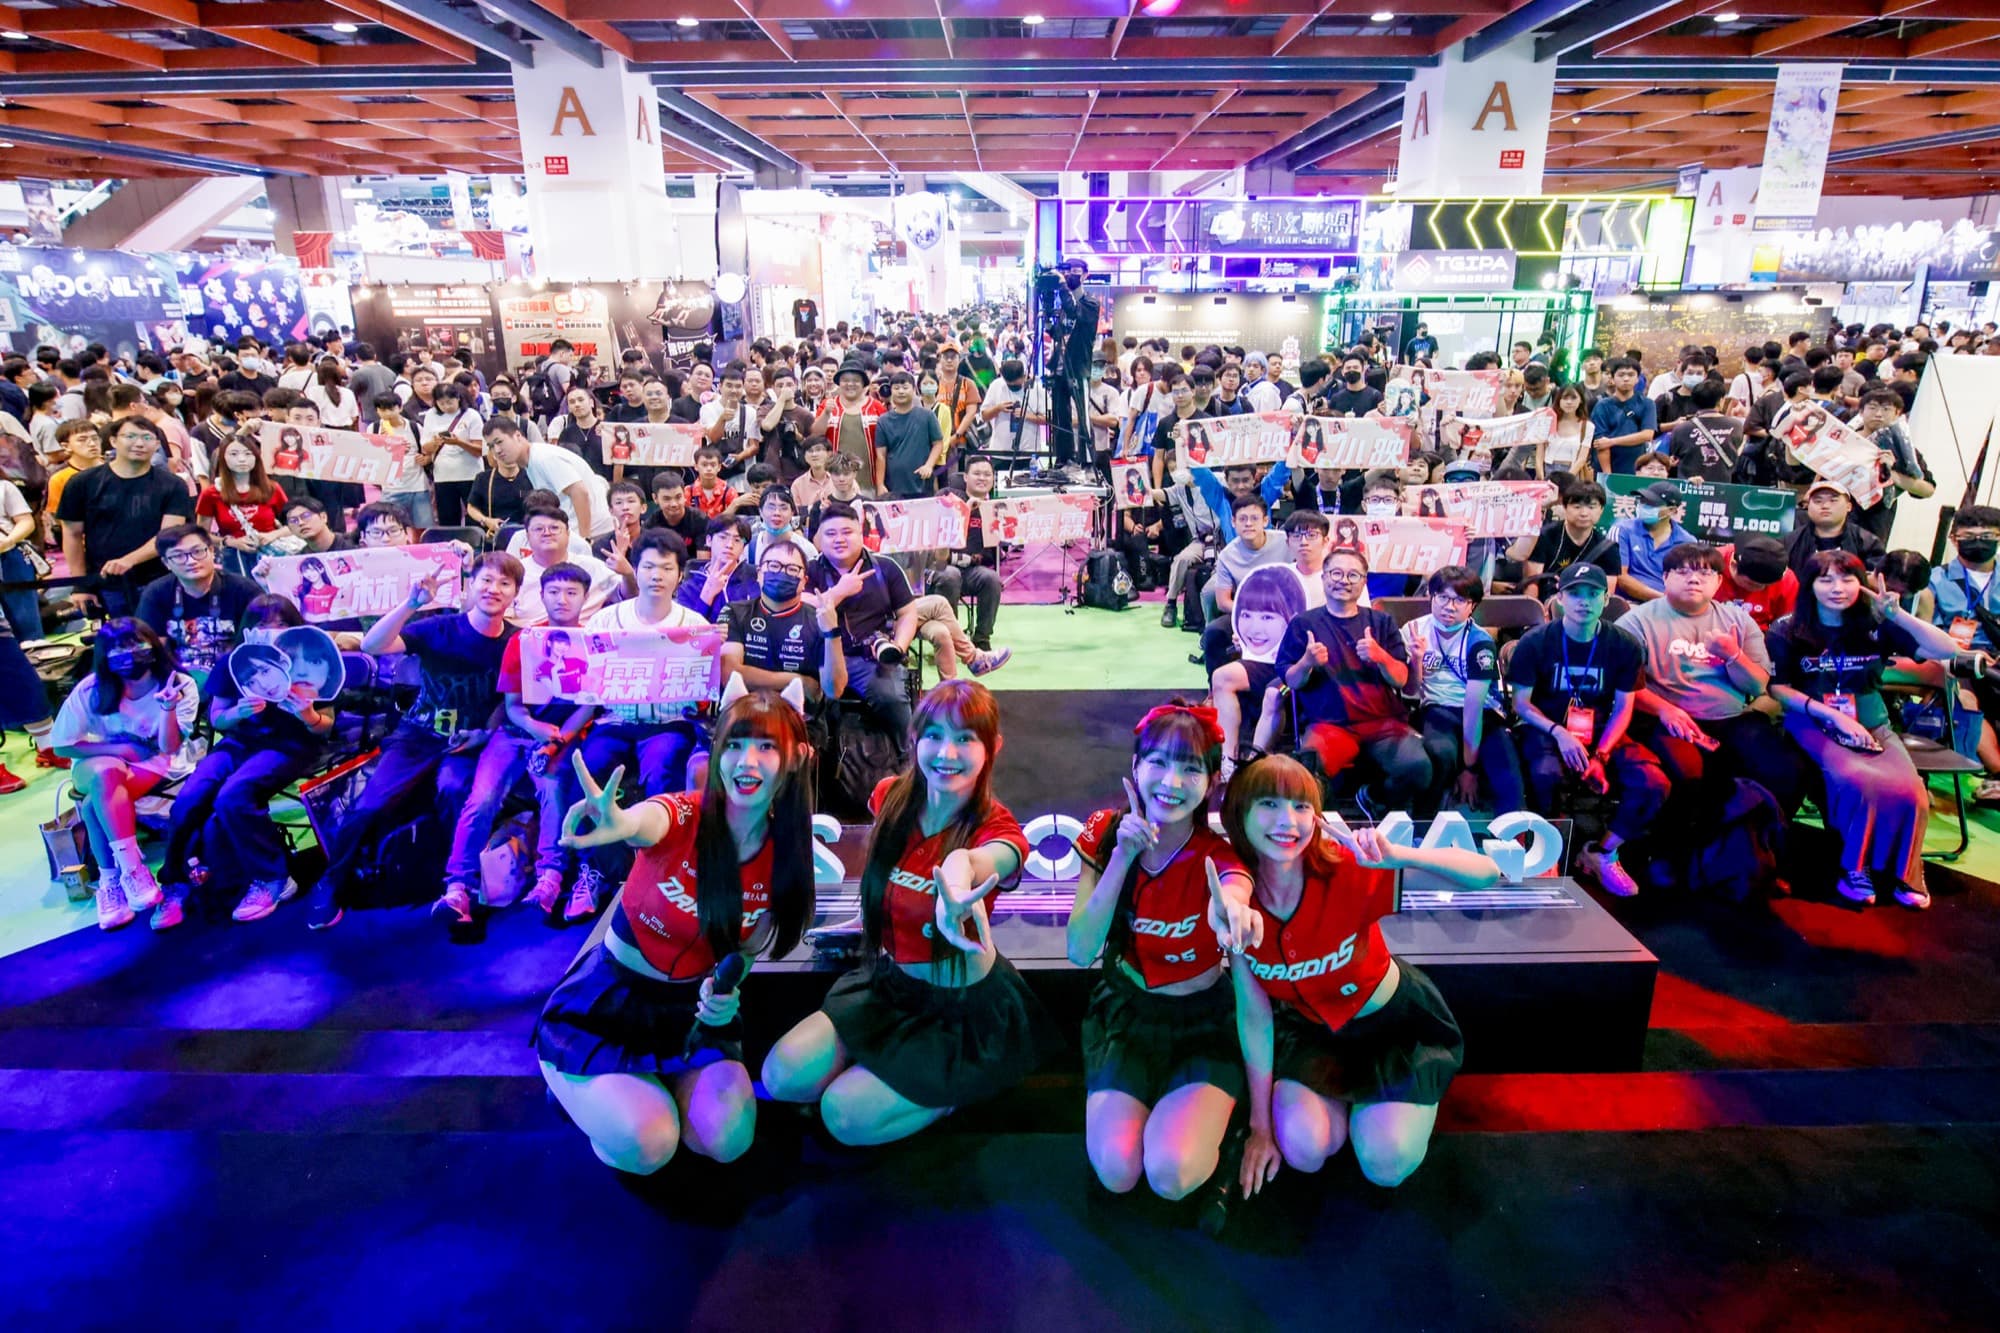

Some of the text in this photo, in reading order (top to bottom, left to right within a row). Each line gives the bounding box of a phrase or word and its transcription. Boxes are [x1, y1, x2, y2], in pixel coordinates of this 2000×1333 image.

[551, 86, 597, 136] A
[1411, 91, 1429, 141] A
[1471, 81, 1518, 130] A
[637, 95, 653, 145] A
[1706, 181, 1723, 206] A
[1435, 255, 1509, 271] TGIPA
[16, 275, 164, 298] MOONLT
[1698, 515, 1781, 533] NT$ 3,000
[1575, 566, 1590, 577] P
[781, 645, 804, 653] INEOS
[602, 656, 714, 700] 霖霖
